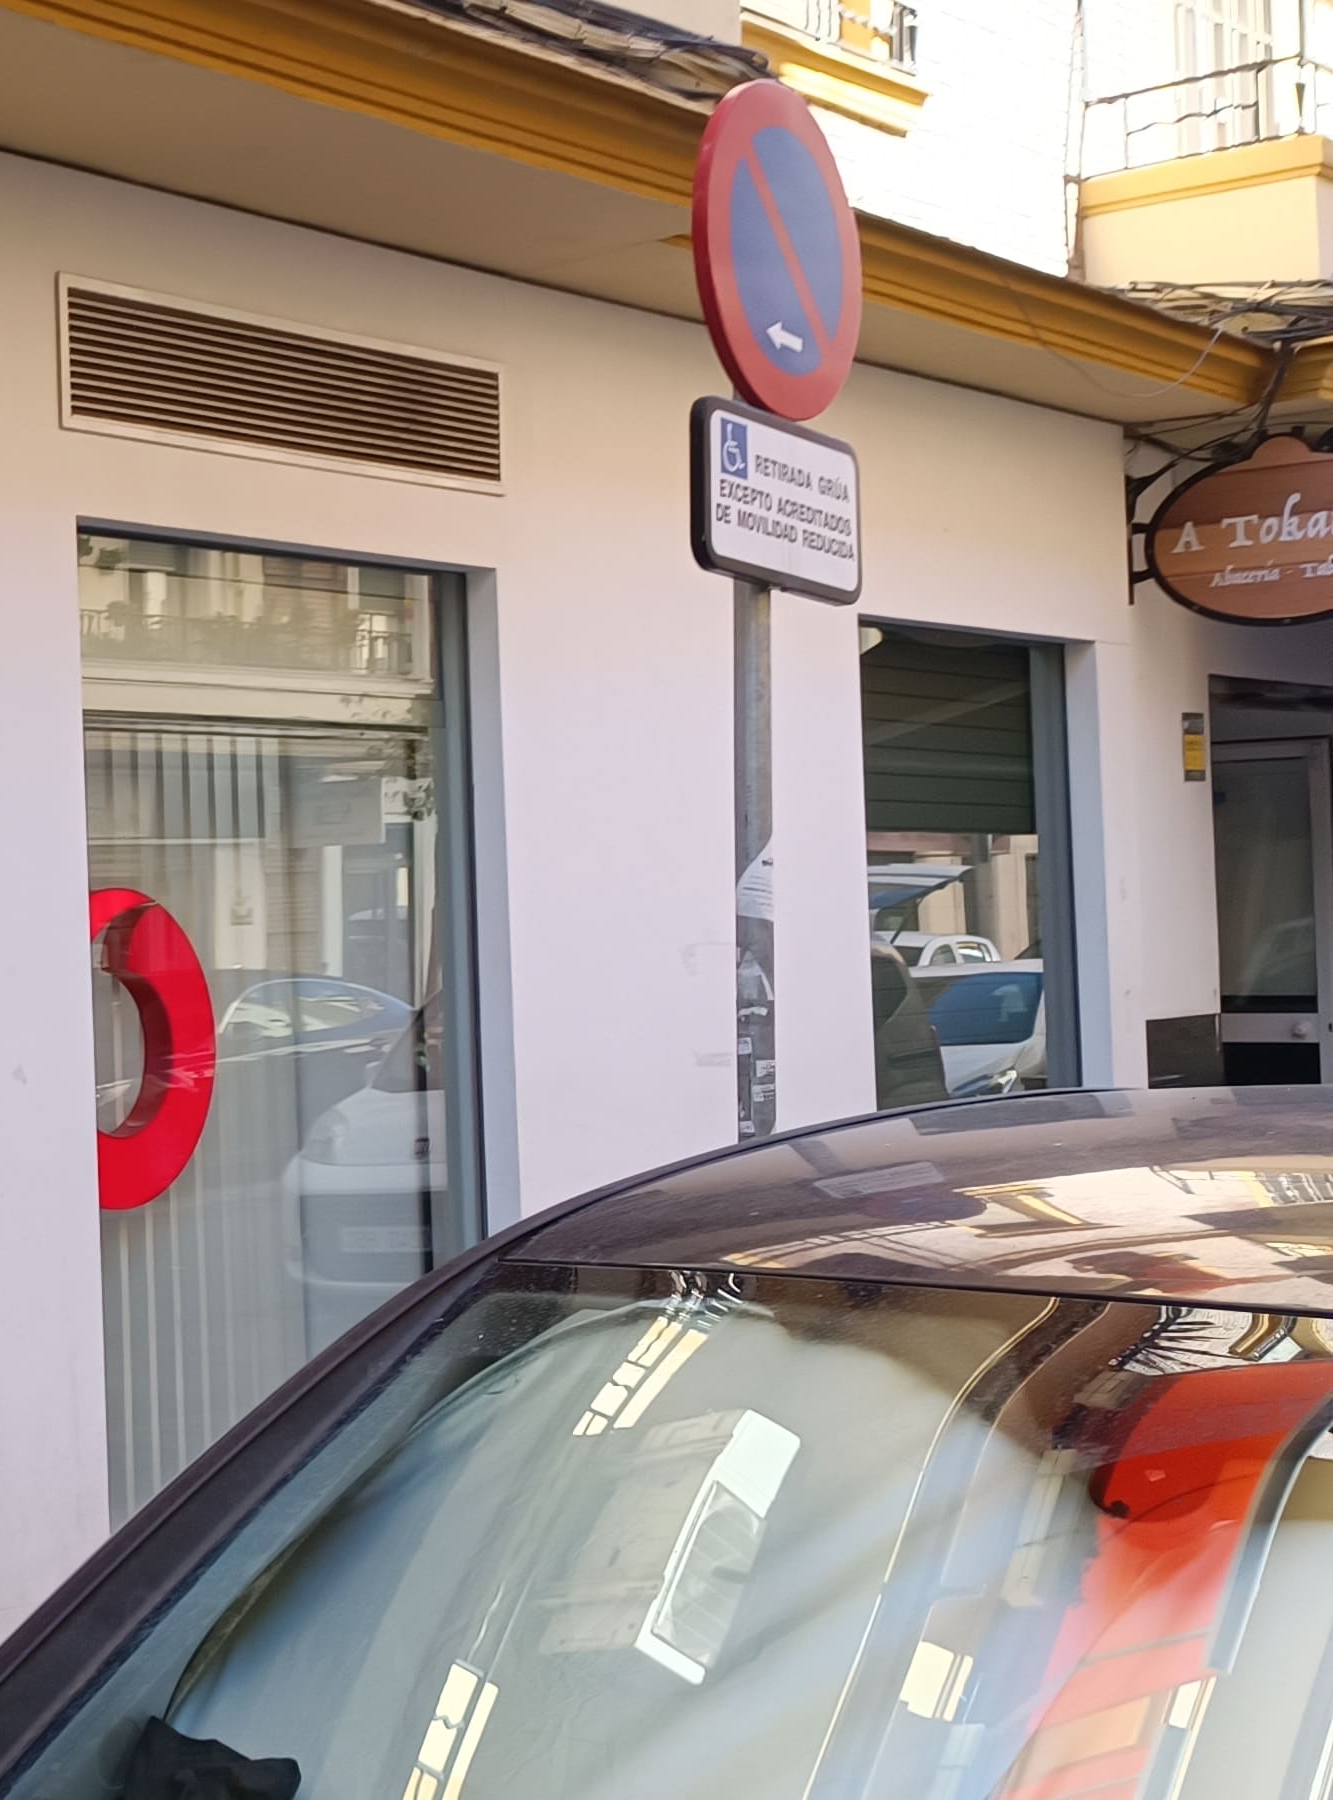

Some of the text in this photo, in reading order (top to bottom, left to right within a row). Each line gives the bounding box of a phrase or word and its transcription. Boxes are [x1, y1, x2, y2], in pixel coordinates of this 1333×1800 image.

[720, 478, 852, 537] EXCEPTO ACREDITADOS
[755, 454, 850, 503] RETIRADA GRÚA
[716, 503, 855, 561] DE MOVILIDAD REDUCIDA
[1172, 492, 1333, 554] A Toka
